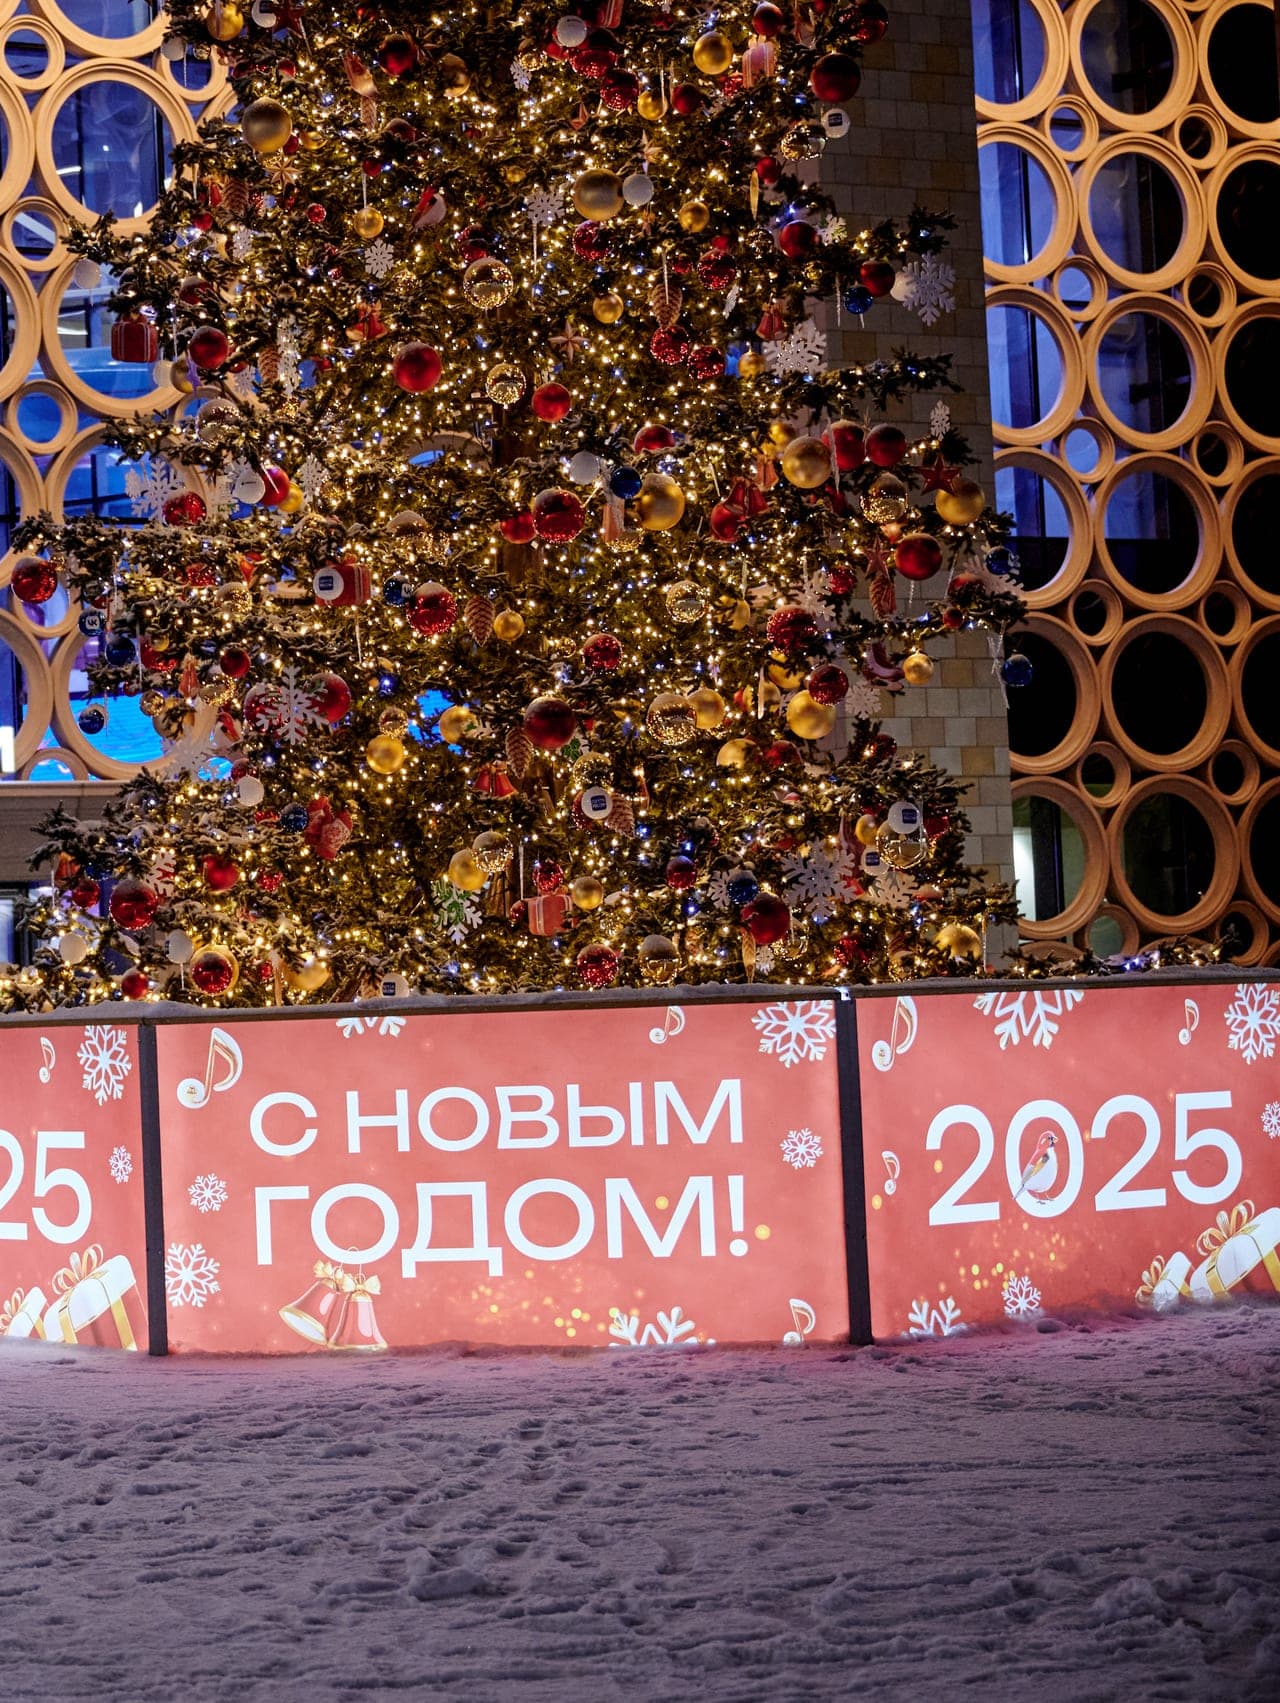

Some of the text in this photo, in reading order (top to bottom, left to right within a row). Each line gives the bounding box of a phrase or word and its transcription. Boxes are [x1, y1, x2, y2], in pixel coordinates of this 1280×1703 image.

[249, 1078, 744, 1157] С НОВЫМ
[925, 1090, 1243, 1226] 2025
[254, 1174, 749, 1278] ГОДОМ!
